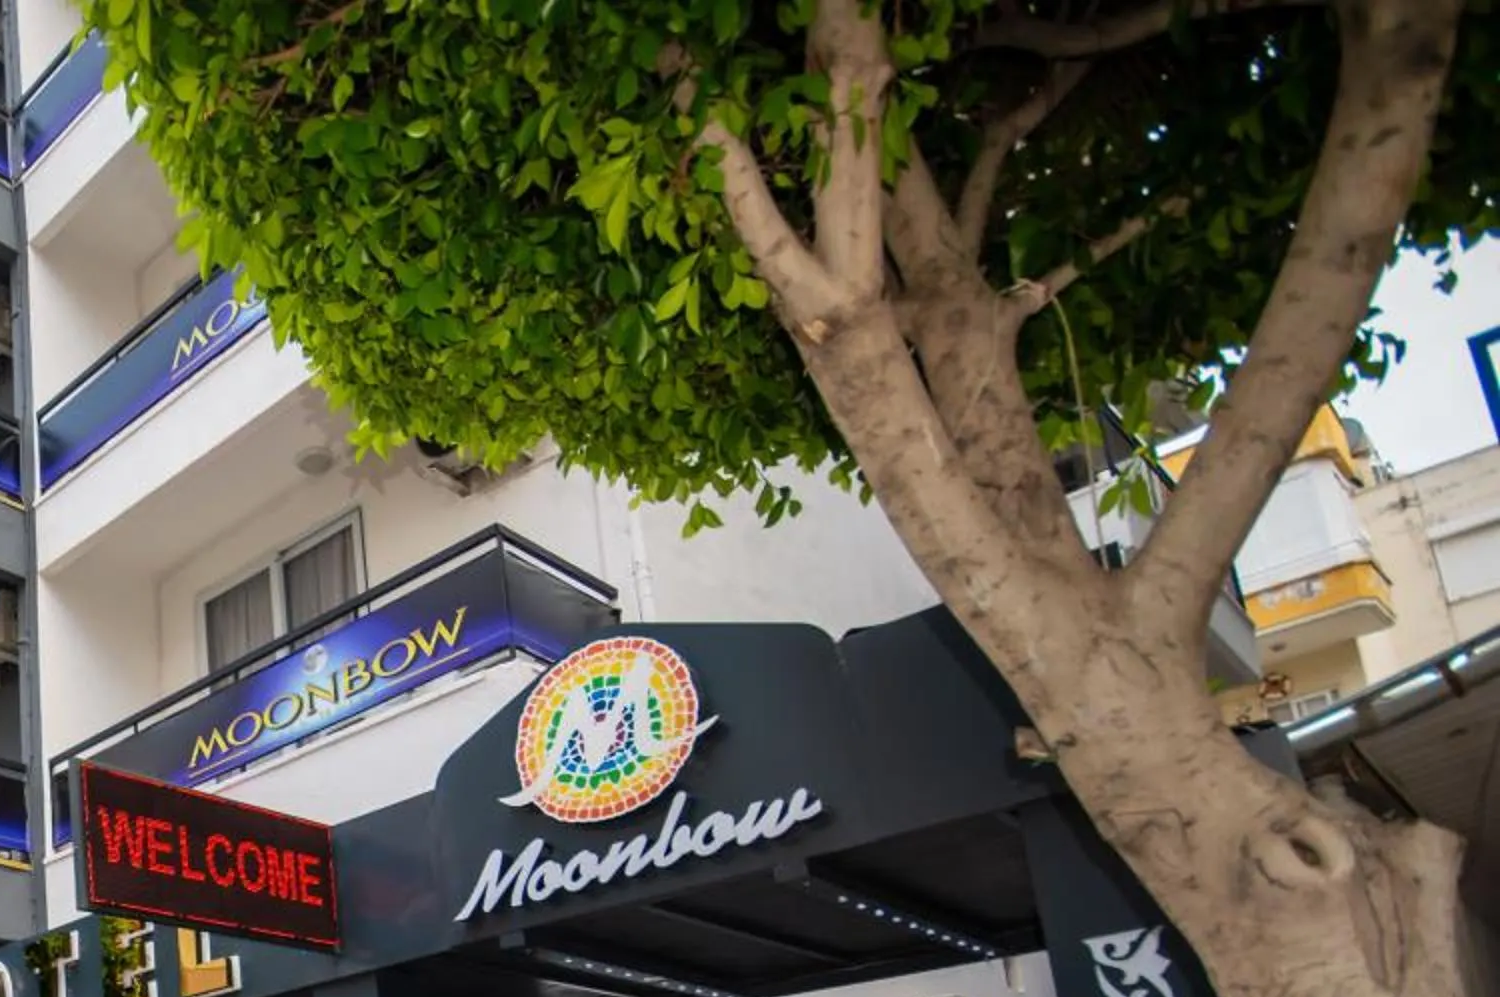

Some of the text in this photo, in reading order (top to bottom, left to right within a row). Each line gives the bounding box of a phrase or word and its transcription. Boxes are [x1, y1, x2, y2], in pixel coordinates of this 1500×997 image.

[188, 606, 468, 768] MOONBOW
[97, 804, 323, 906] WELCOME
[453, 788, 822, 922] Moonbow
